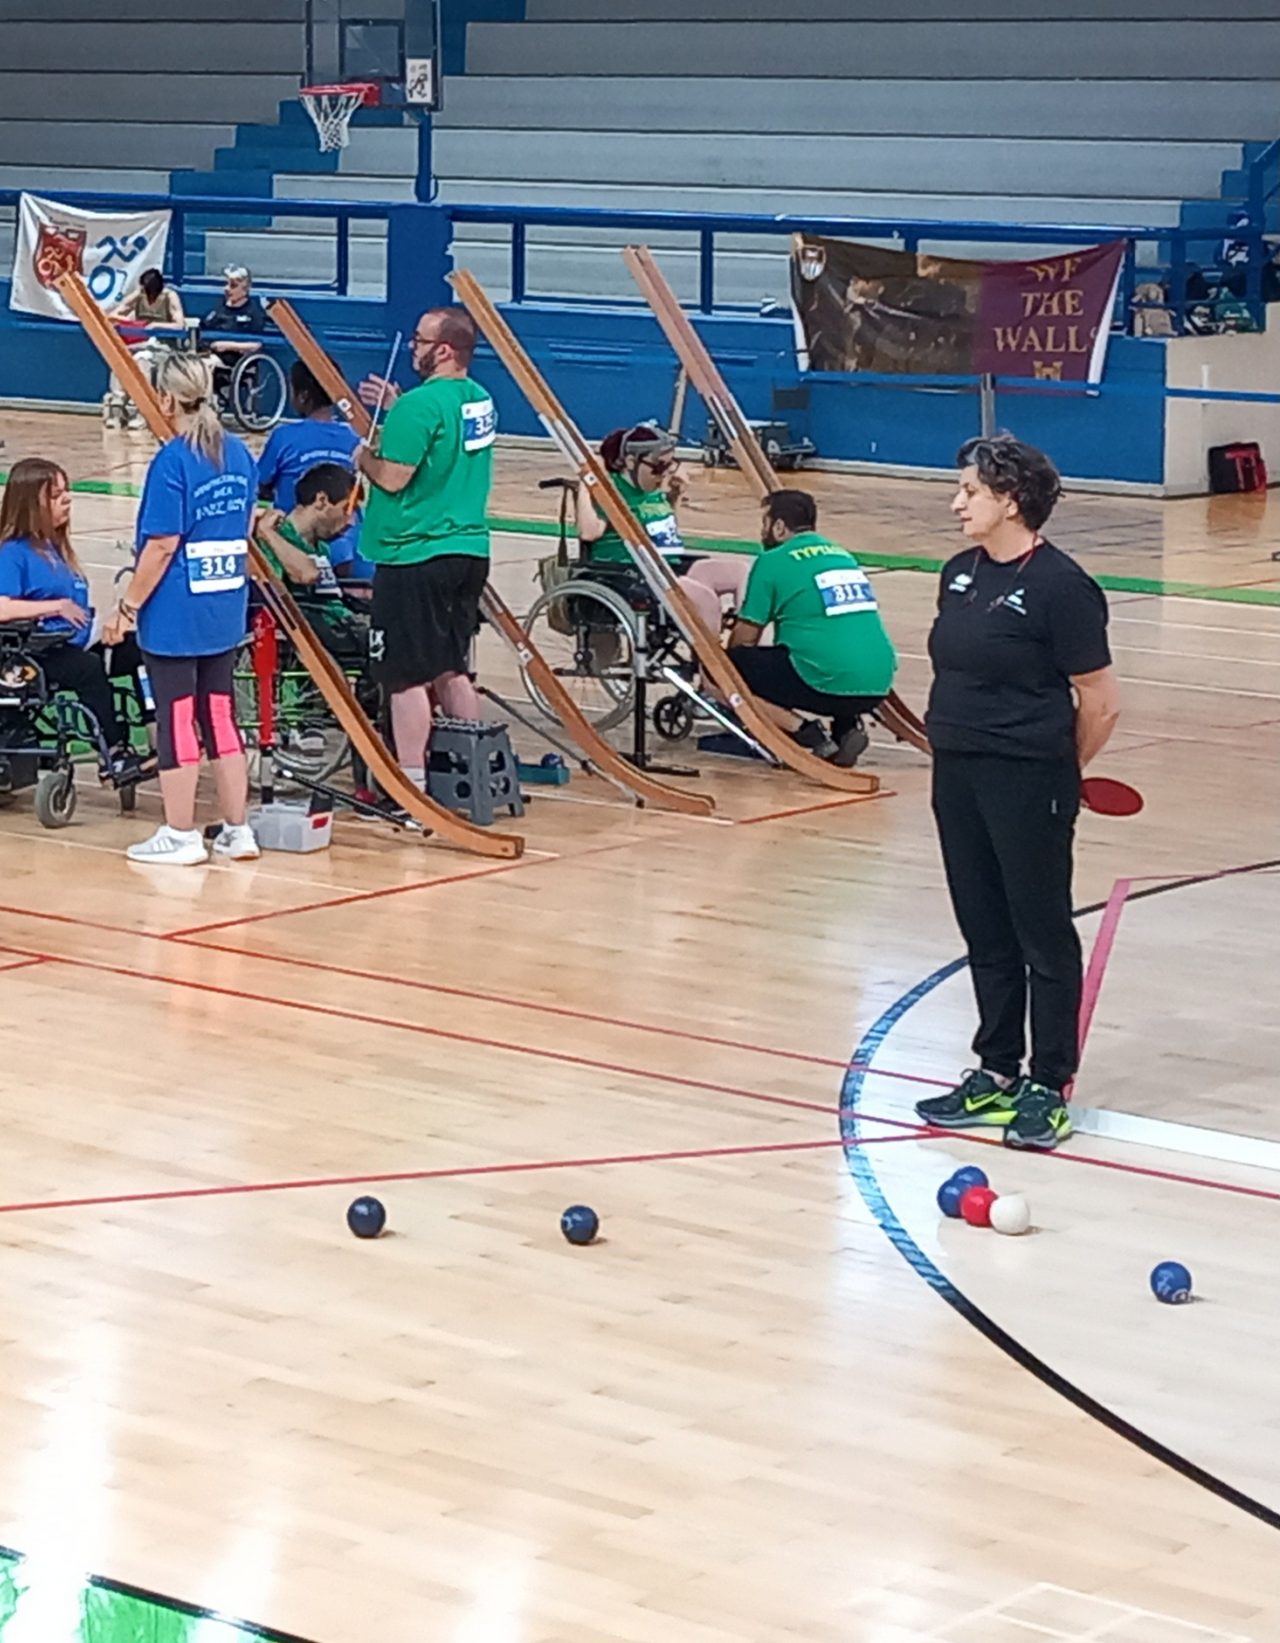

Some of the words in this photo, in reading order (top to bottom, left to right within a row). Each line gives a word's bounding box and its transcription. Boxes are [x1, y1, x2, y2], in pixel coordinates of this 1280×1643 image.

[1021, 289, 1084, 317] THE
[993, 325, 1088, 353] WALL
[200, 555, 236, 578] 314
